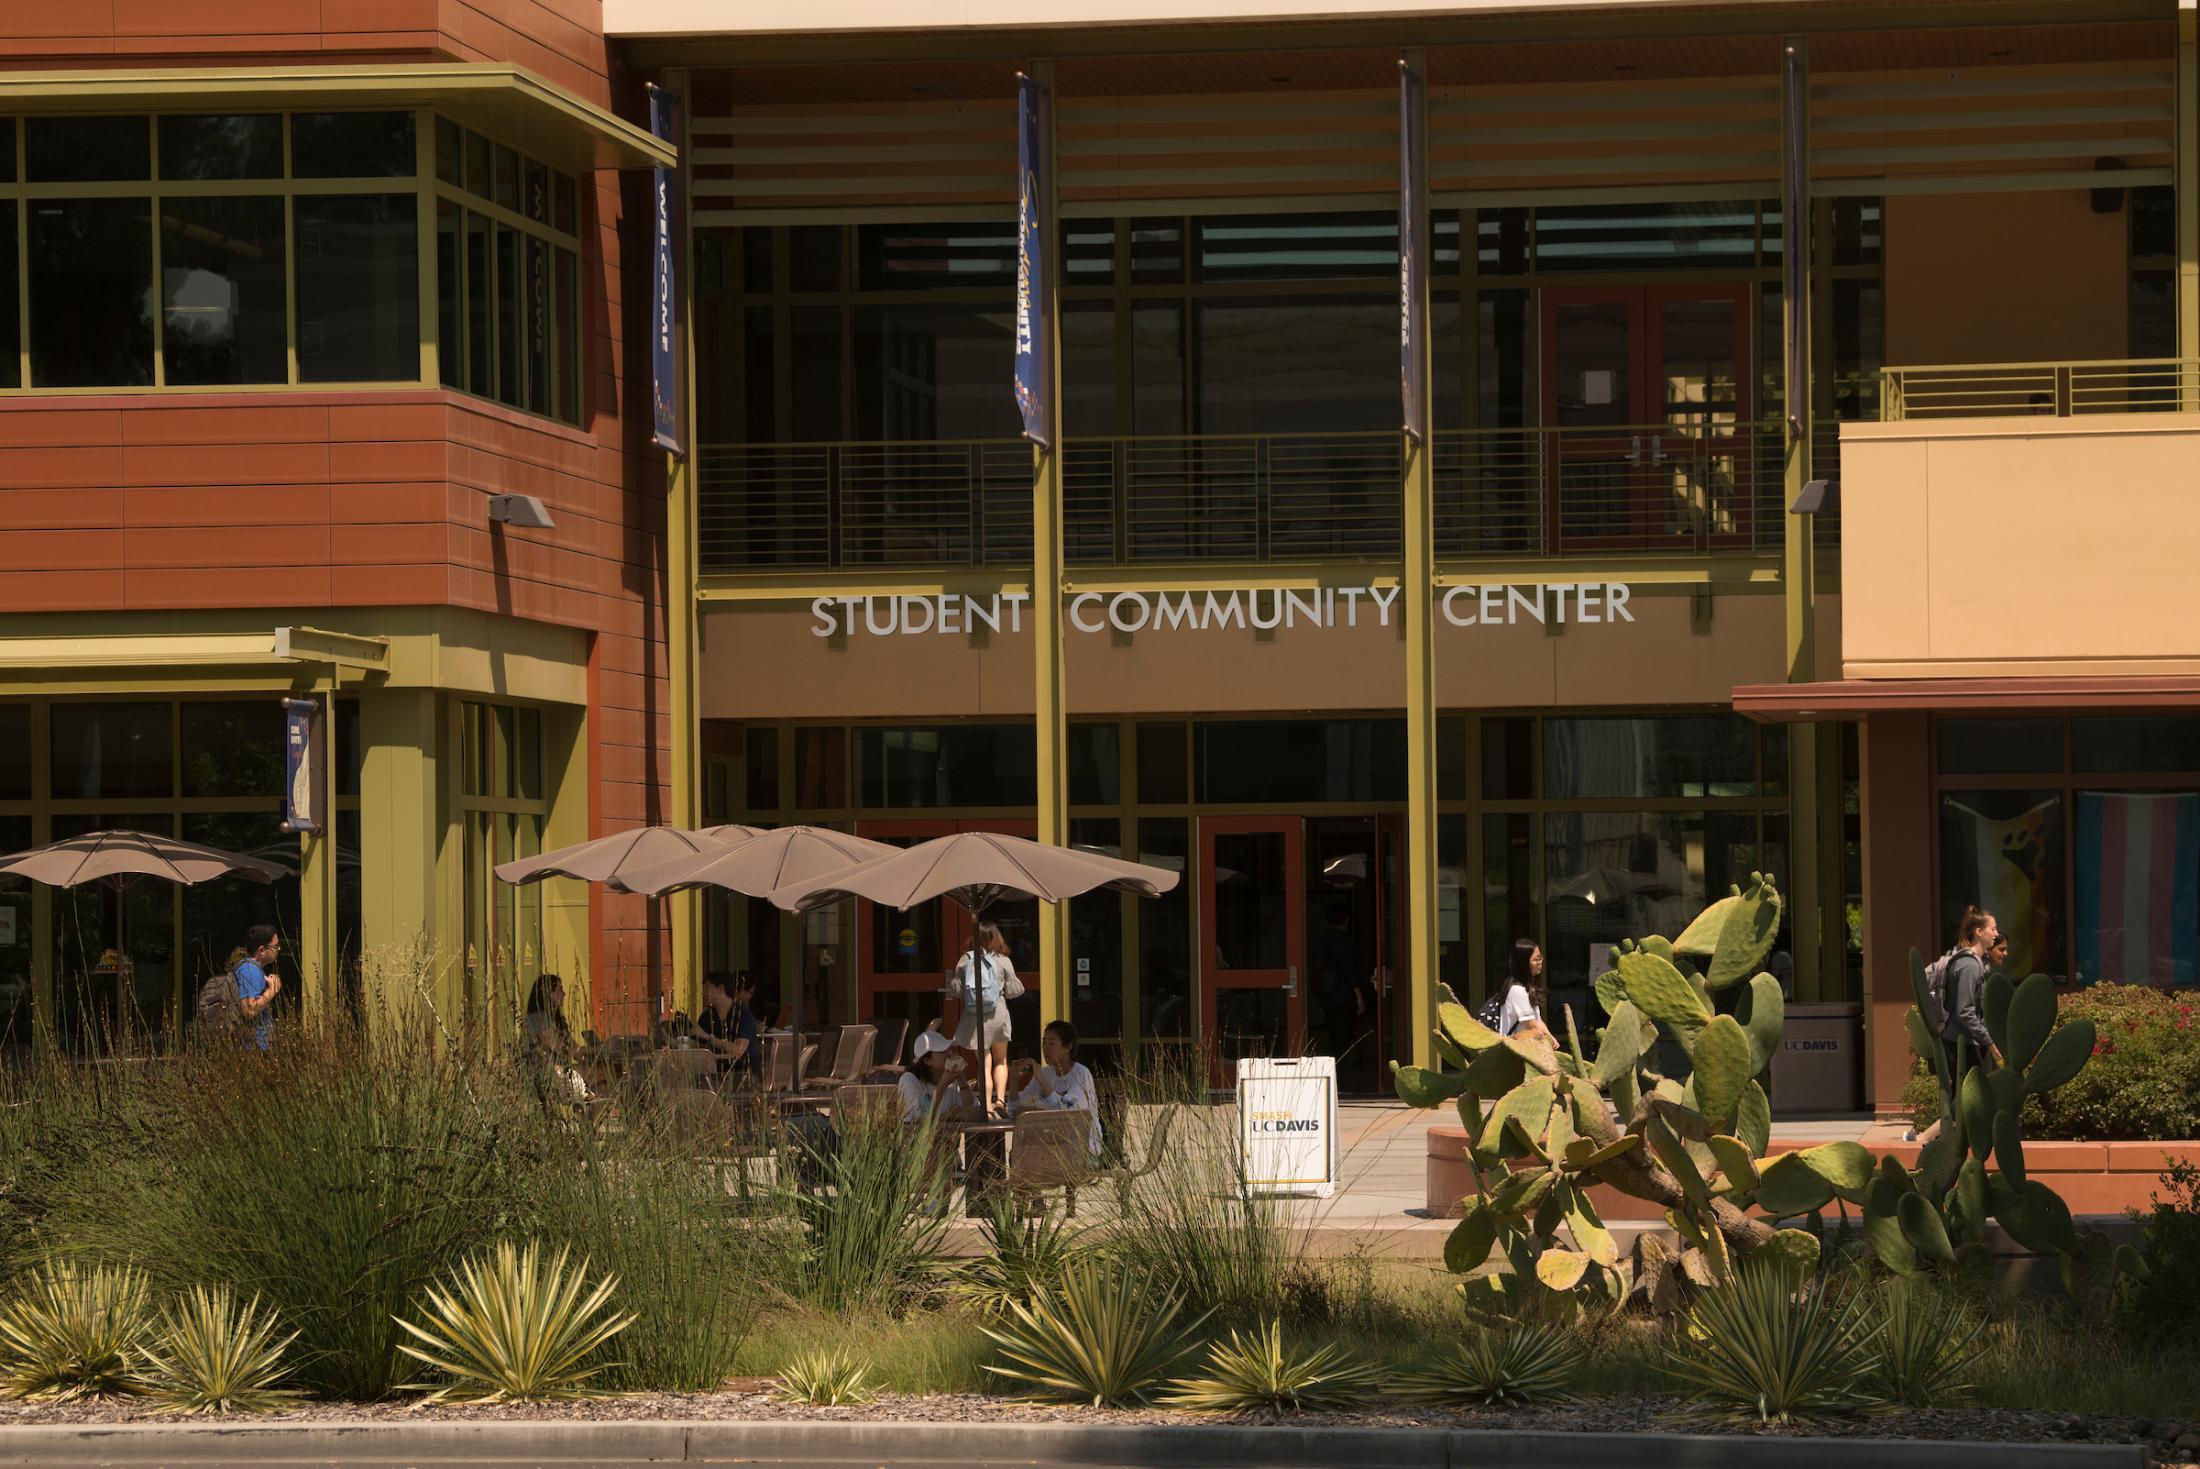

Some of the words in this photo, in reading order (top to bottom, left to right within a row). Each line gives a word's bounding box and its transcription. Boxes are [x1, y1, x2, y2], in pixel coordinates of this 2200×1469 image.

[660, 182, 669, 352] WELCOME
[810, 593, 1030, 637] STUDENT
[1069, 586, 1401, 633] COMMUNITY
[1442, 583, 1636, 627] CENTER
